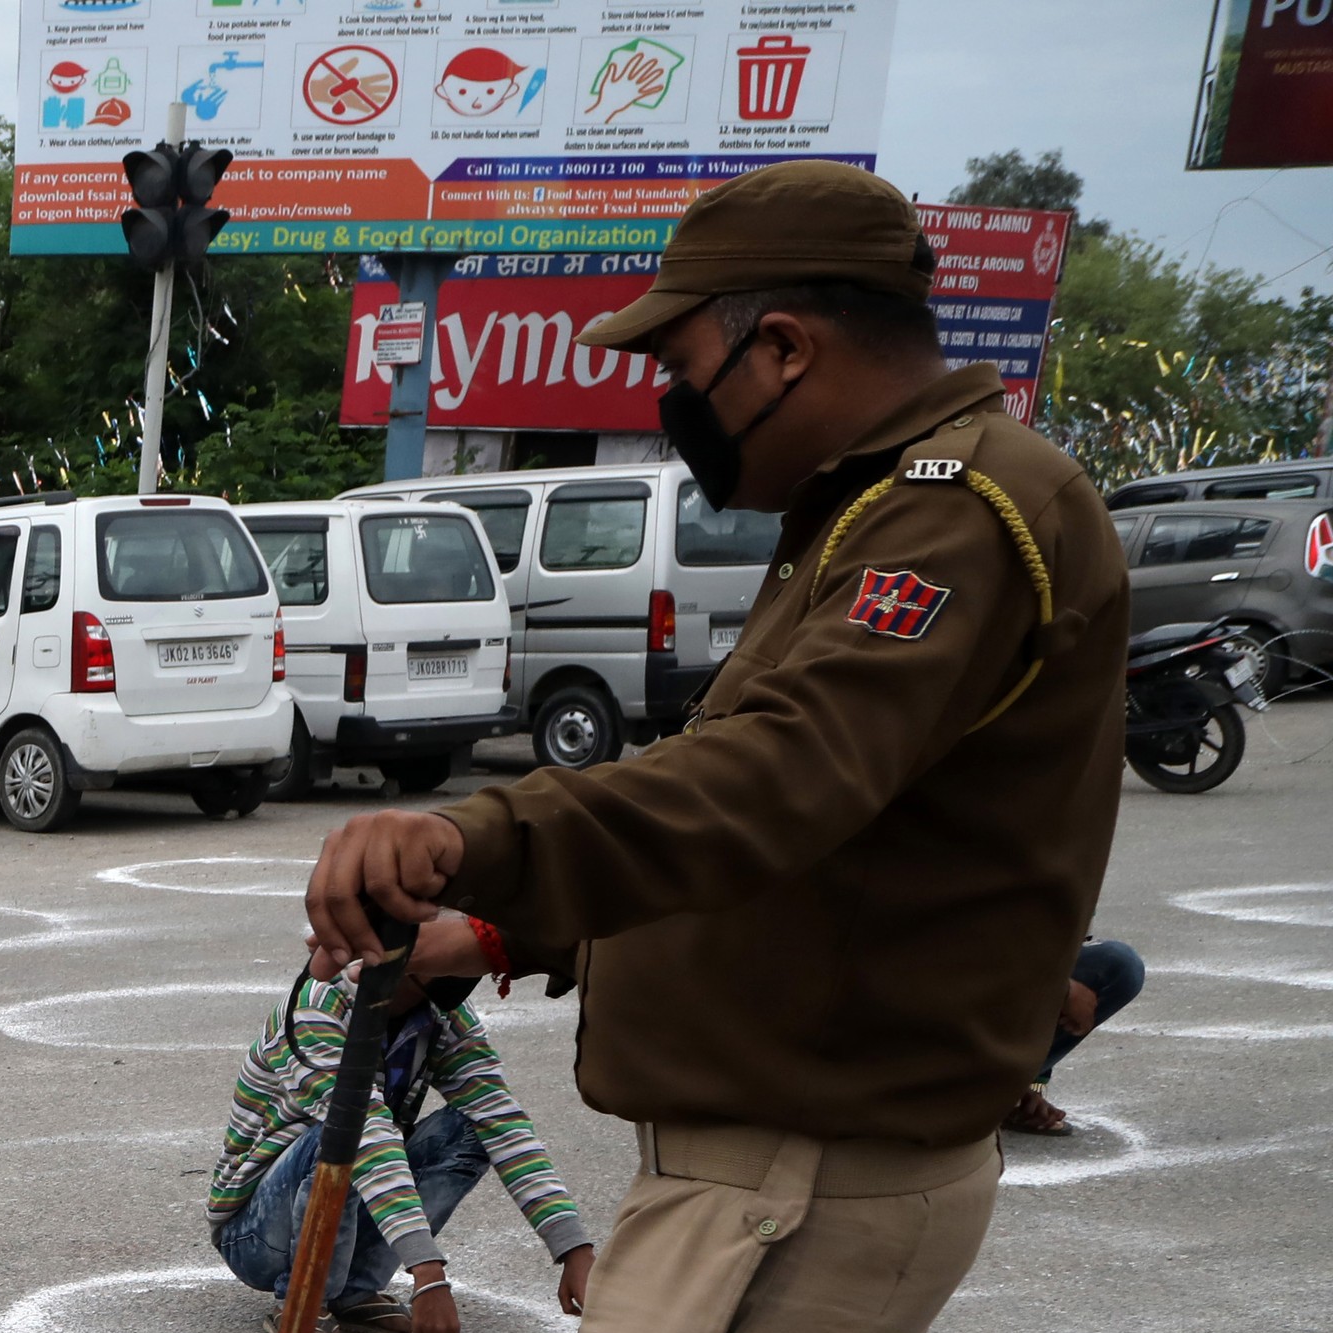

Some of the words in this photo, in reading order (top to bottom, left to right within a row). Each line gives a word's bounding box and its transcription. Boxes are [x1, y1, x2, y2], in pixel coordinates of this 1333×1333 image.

[208, 32, 224, 40] food
[226, 31, 266, 42] preparation
[720, 126, 730, 134] 12.
[732, 125, 752, 136] keep
[752, 125, 788, 136] separate
[790, 125, 796, 133] &
[798, 124, 830, 133] covered
[719, 140, 752, 148] dustbins
[754, 140, 764, 148] for
[766, 140, 786, 148] food
[786, 139, 810, 148] waste
[259, 169, 271, 181] to
[277, 167, 342, 183] company
[346, 168, 387, 180] name
[467, 164, 492, 176] Call
[497, 163, 520, 175] Toll
[525, 163, 553, 175] Free
[559, 162, 614, 175] 1800112
[622, 163, 645, 174] 100
[657, 162, 683, 174] Sms
[687, 162, 704, 173] Or
[20, 171, 30, 184] if
[34, 173, 58, 187] any
[62, 171, 117, 184] concern
[20, 190, 84, 203] download
[88, 188, 116, 201] fssai
[441, 189, 481, 200] Connect
[486, 189, 511, 200] With
[547, 189, 572, 200] Food
[575, 188, 608, 202] Safety
[612, 188, 632, 199] And
[636, 187, 689, 199] Standards
[19, 209, 33, 220] or
[36, 206, 72, 222] logon
[507, 204, 554, 218] always
[559, 203, 598, 217] quote
[947, 212, 982, 230] WING
[984, 214, 1032, 233] JAMMU
[273, 226, 326, 250] Drug
[334, 226, 350, 246] &
[359, 226, 414, 246] Food
[420, 224, 504, 246] Control
[511, 222, 656, 248] Organization
[938, 254, 982, 270] ARTICLE
[982, 256, 1025, 272] AROUND
[905, 459, 963, 480] JKP
[164, 646, 189, 662] JK02
[192, 646, 204, 660] AG
[207, 644, 232, 660] 3646
